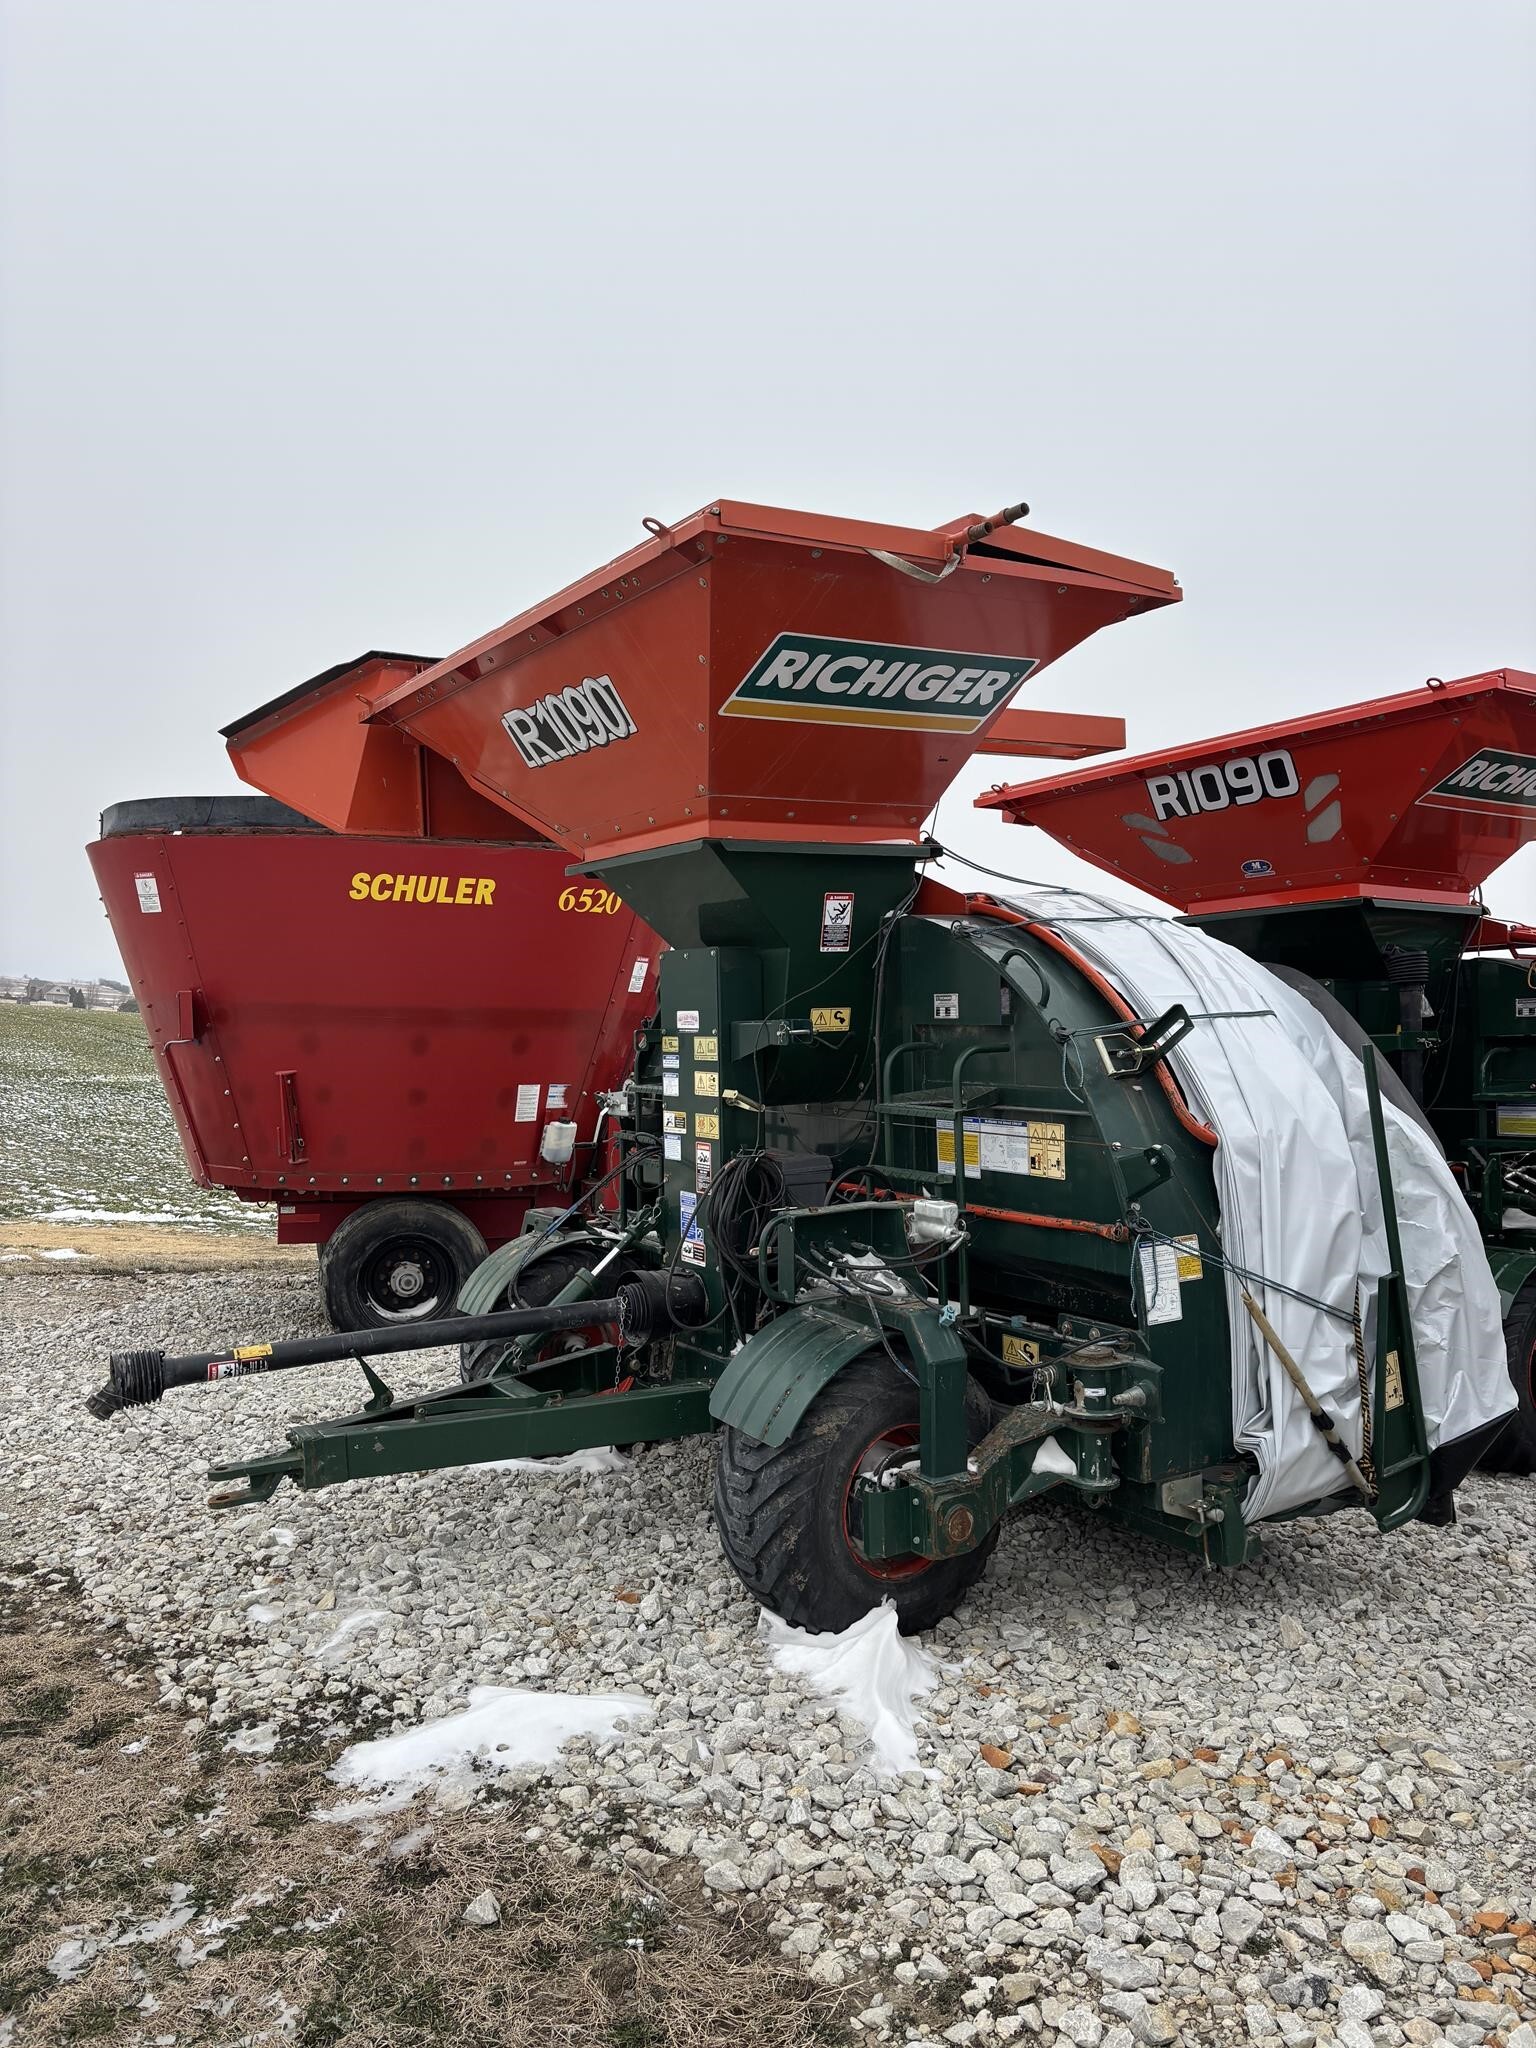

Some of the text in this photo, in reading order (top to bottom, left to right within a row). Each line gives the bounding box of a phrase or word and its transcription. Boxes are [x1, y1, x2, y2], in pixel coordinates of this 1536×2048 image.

[755, 649, 1011, 706] RICHIGER
[503, 677, 629, 766] R1090
[1146, 749, 1300, 821] R1090
[349, 872, 496, 905] SCHULER
[558, 886, 622, 915] 6520
